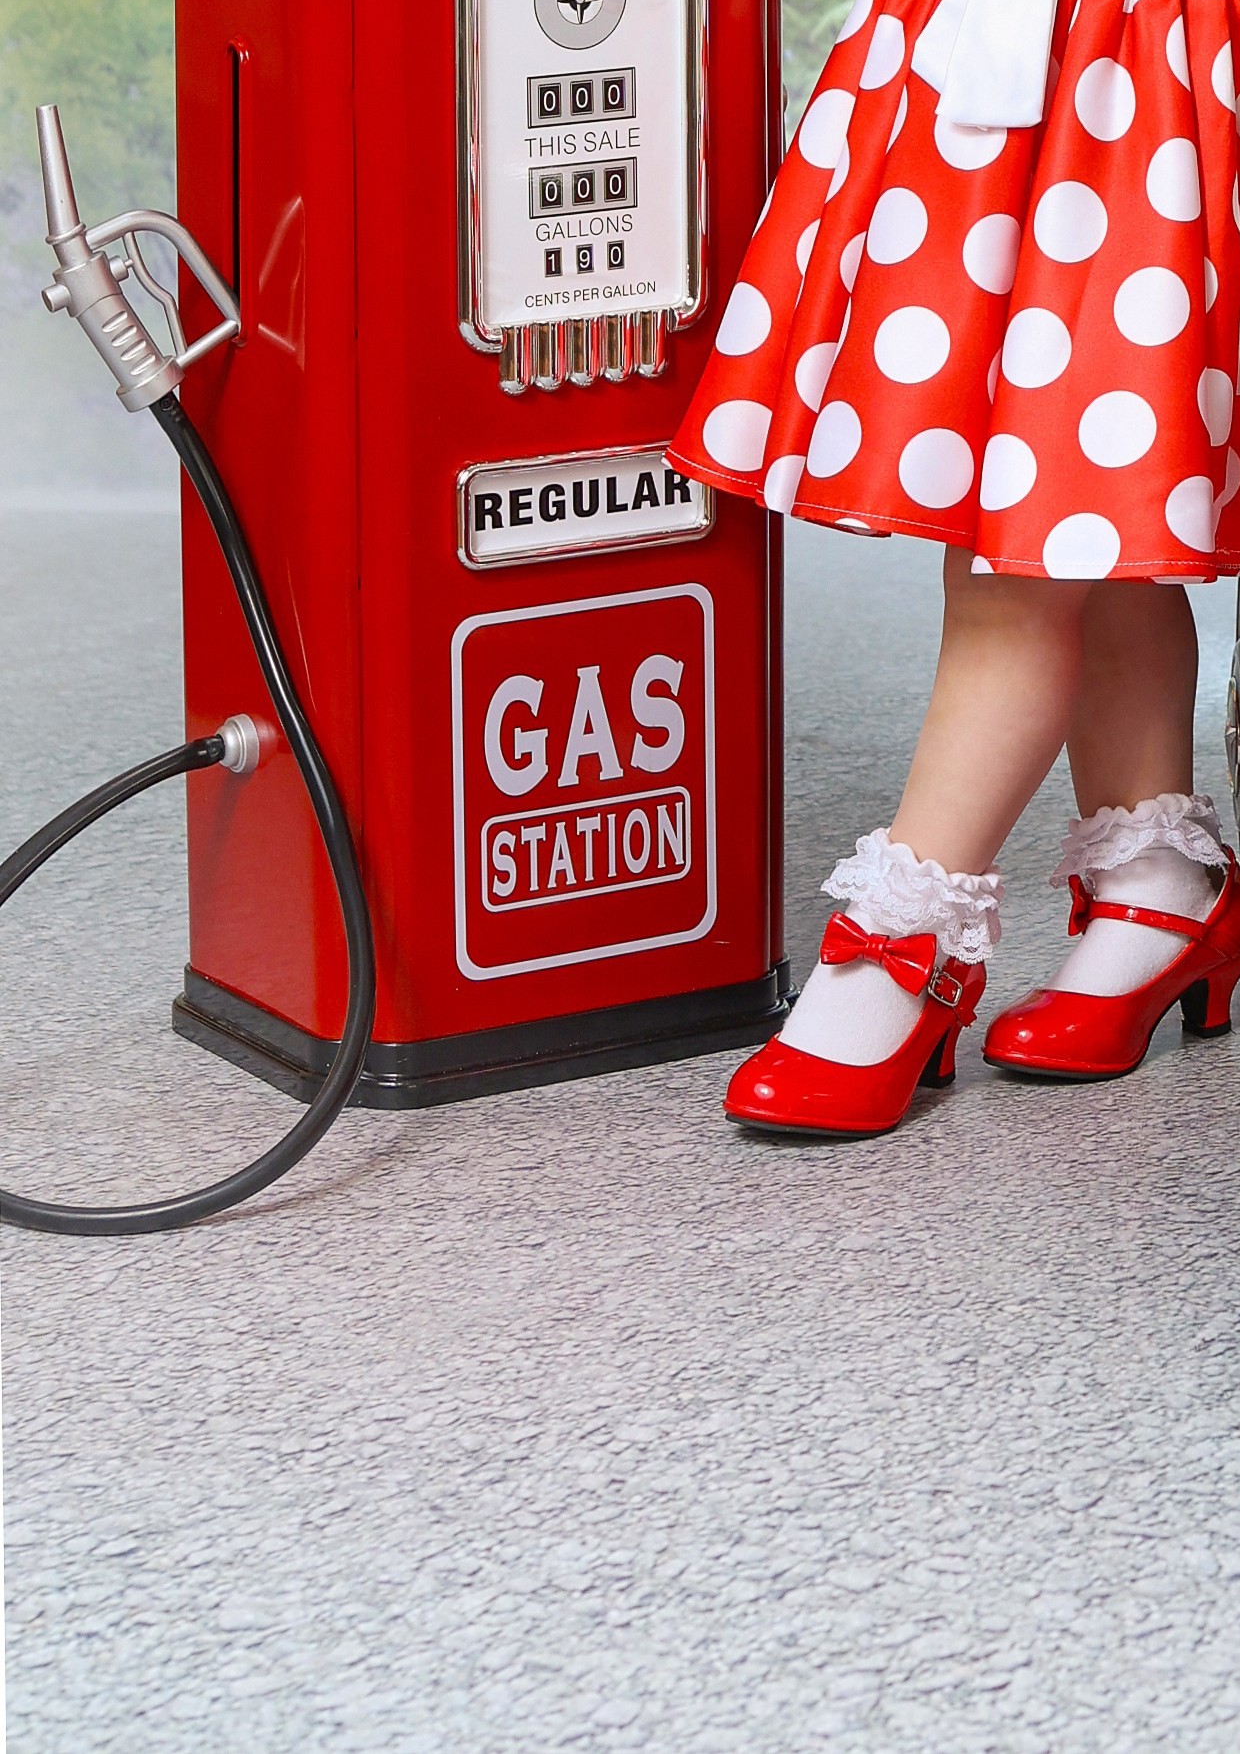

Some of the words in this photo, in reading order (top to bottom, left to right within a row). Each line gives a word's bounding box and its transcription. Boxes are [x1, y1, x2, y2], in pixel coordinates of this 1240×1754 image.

[524, 133, 577, 158] THIS
[583, 127, 641, 153] SALE
[535, 213, 633, 242] GALLONS
[524, 291, 570, 308] CENTS
[573, 287, 600, 302] PER
[602, 281, 656, 299] GALLON
[474, 468, 692, 531] REGULAR
[483, 654, 686, 796] GAS
[492, 801, 685, 898] STATION
